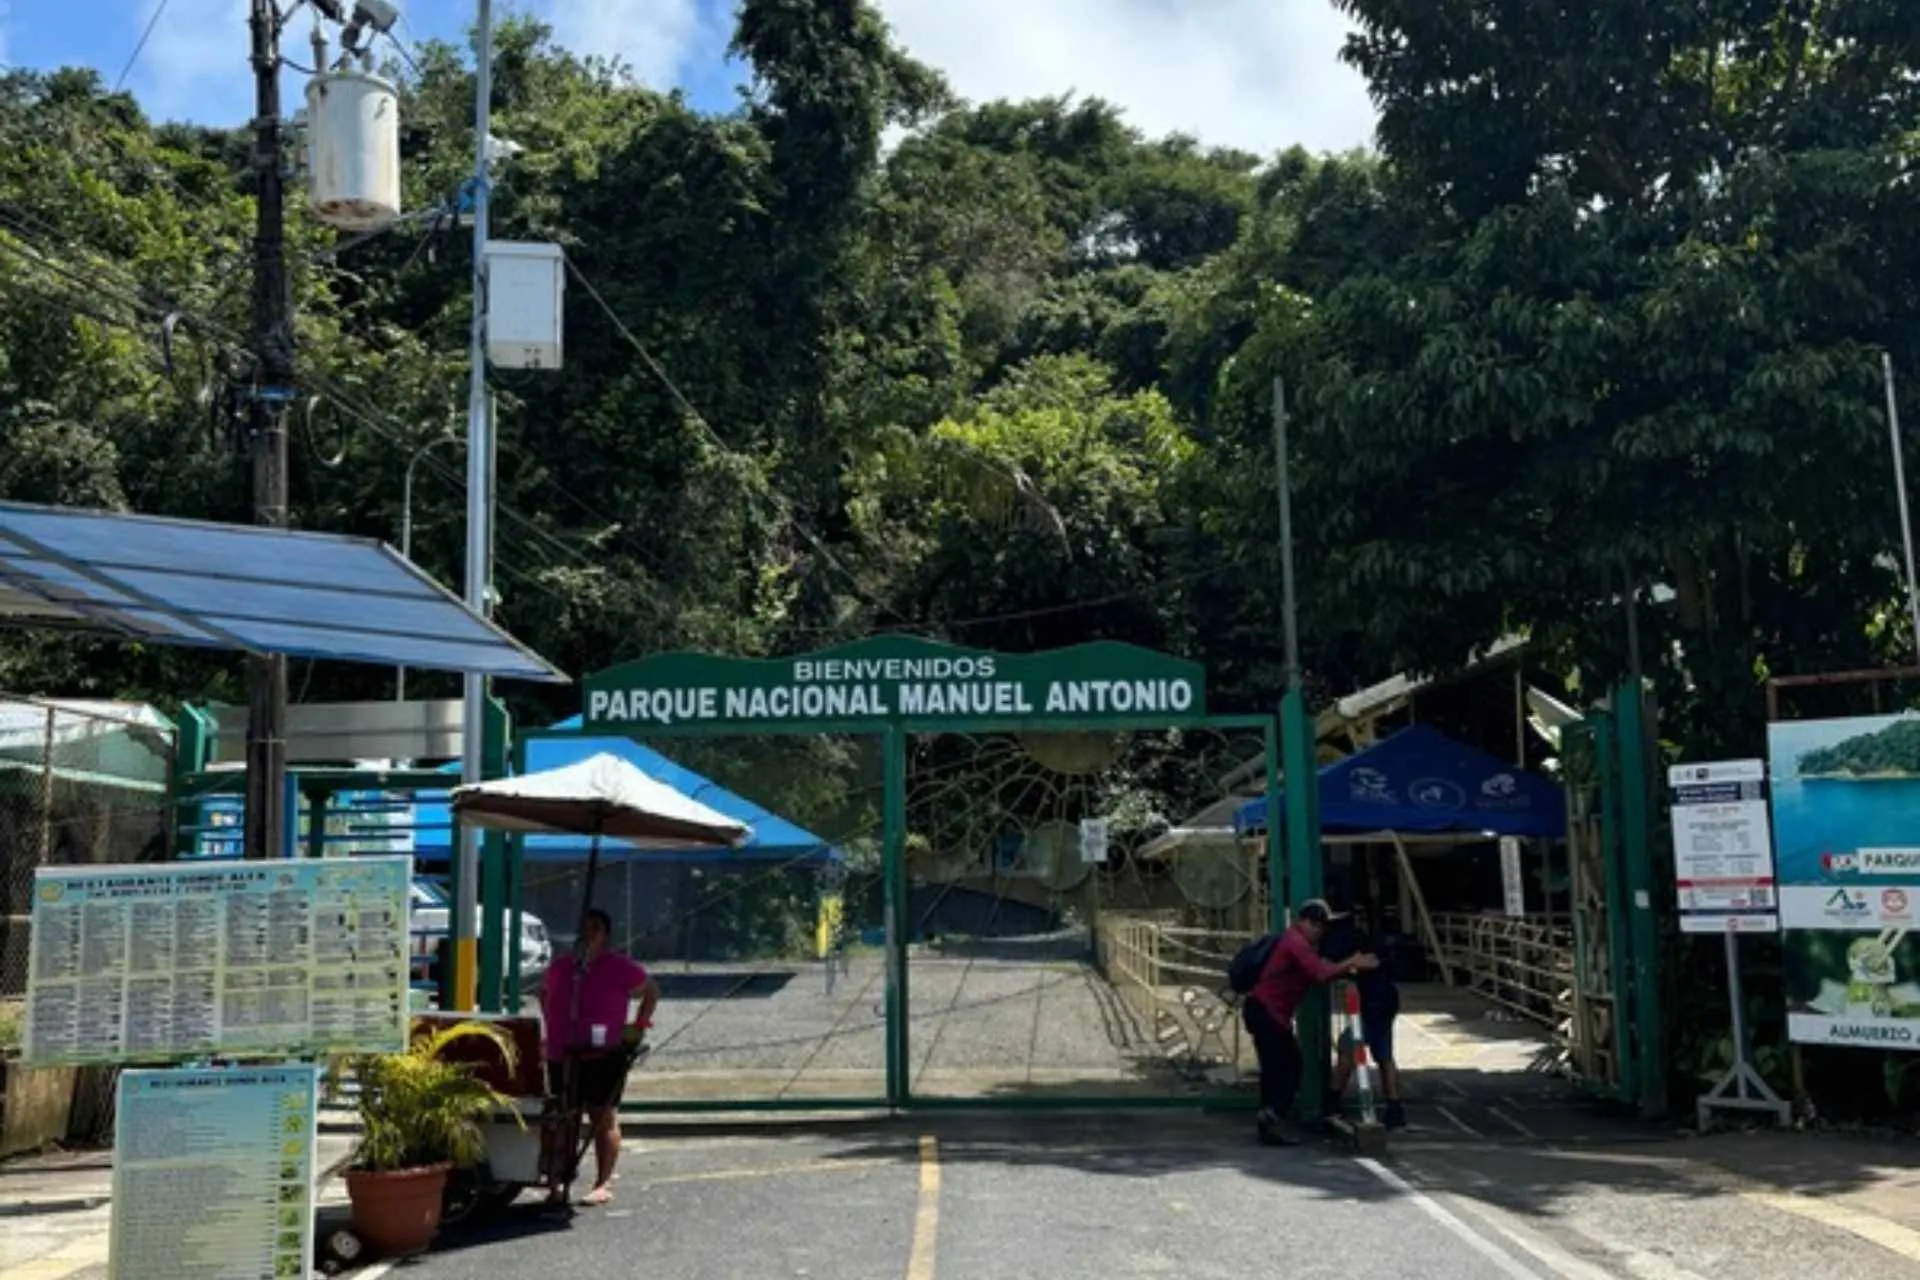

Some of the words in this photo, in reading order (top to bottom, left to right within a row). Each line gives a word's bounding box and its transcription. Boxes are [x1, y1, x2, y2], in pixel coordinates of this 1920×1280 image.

[793, 656, 996, 681] BIENVENIDOS
[589, 687, 717, 724] PARQUE
[725, 683, 889, 718] NACIONAL
[899, 681, 1033, 715] MANUEL
[1045, 679, 1192, 712] ANTONIO
[1863, 852, 1920, 868] PARQU
[1829, 1023, 1912, 1042] ALMUERZO
